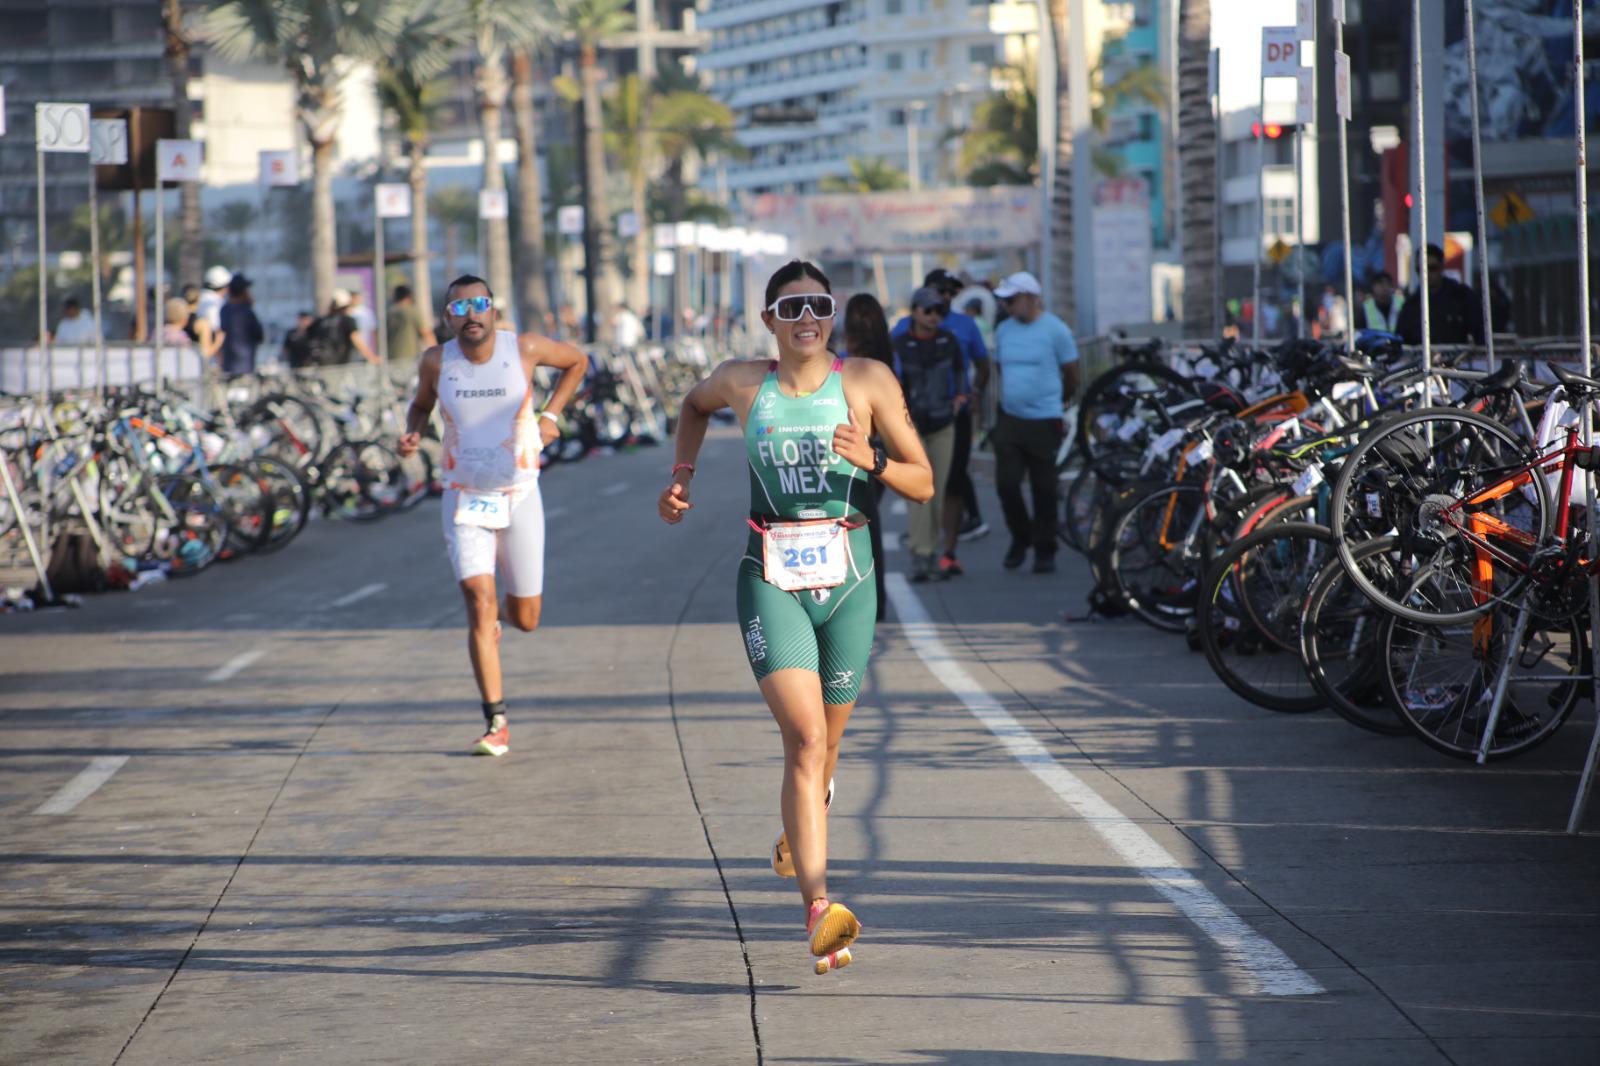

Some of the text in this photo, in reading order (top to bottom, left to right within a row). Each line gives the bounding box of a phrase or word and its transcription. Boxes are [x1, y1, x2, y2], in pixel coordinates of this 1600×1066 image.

[1266, 42, 1294, 62] DP
[43, 106, 85, 147] SO
[171, 152, 187, 168] A
[455, 387, 507, 399] FERRARI
[777, 465, 833, 494] MEX
[467, 500, 499, 514] 275
[783, 545, 828, 568] 261
